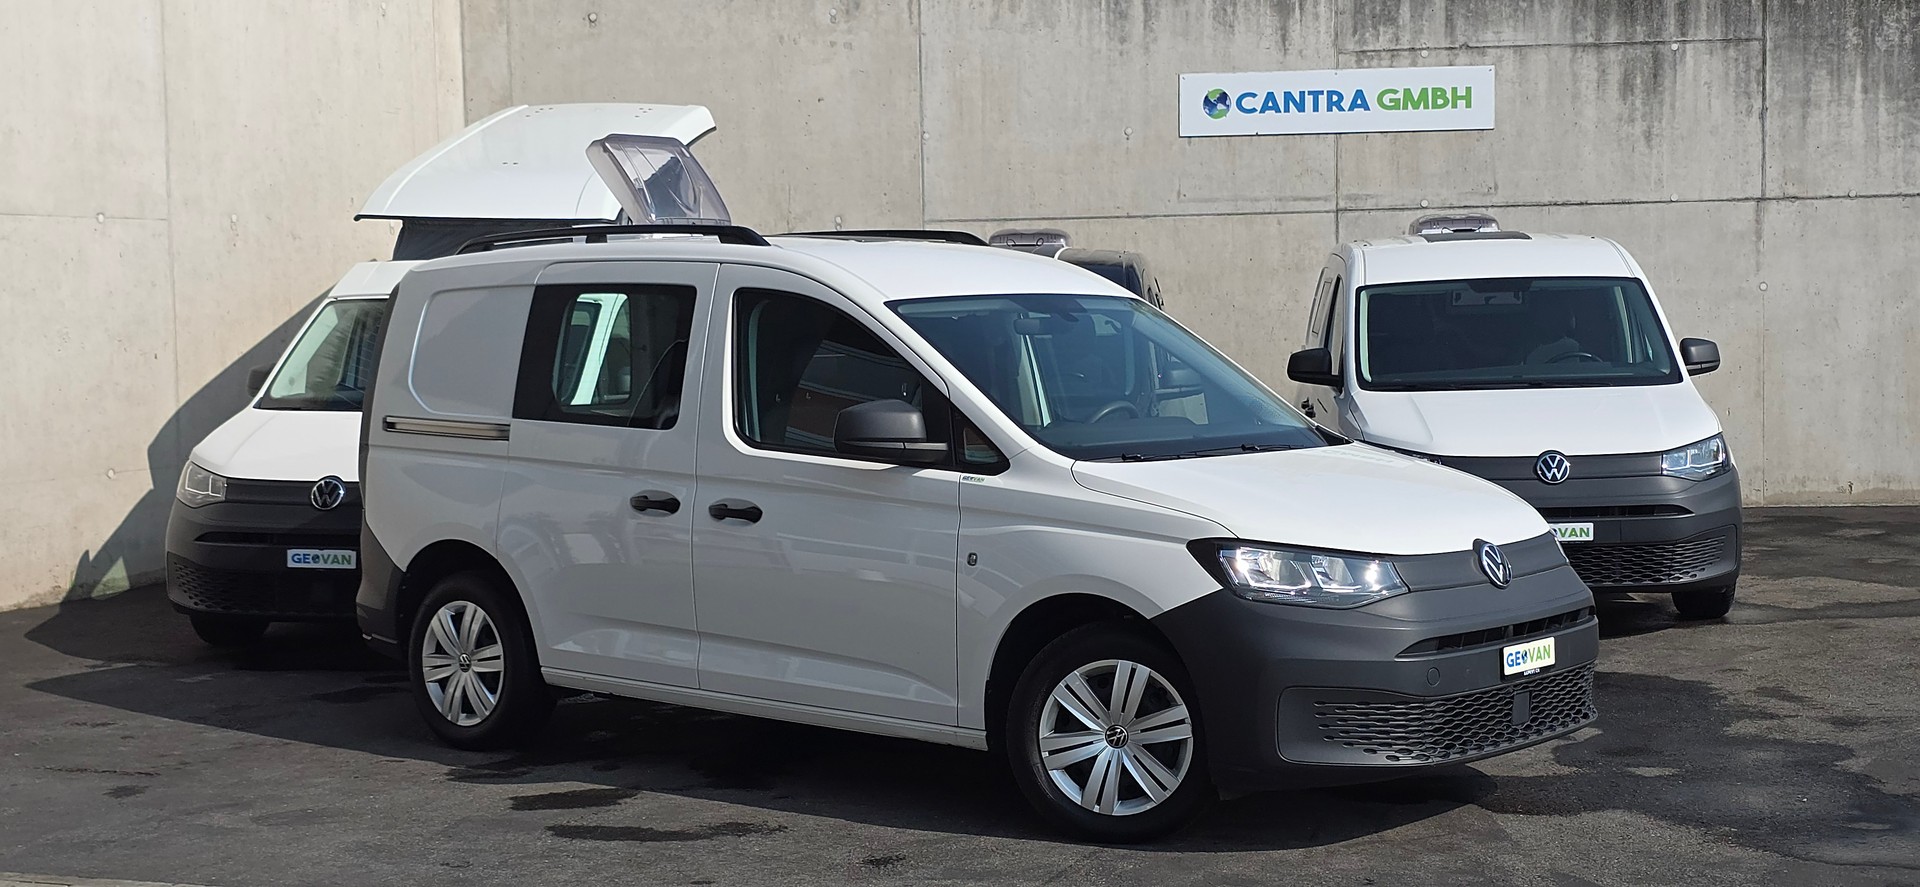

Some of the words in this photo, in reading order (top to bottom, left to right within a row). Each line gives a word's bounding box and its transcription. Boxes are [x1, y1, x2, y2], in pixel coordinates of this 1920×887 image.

[1235, 88, 1371, 115] CANTRA
[1376, 85, 1473, 112] GMBH
[291, 553, 352, 565] GEOVAN
[1506, 644, 1551, 668] GEOVAN
